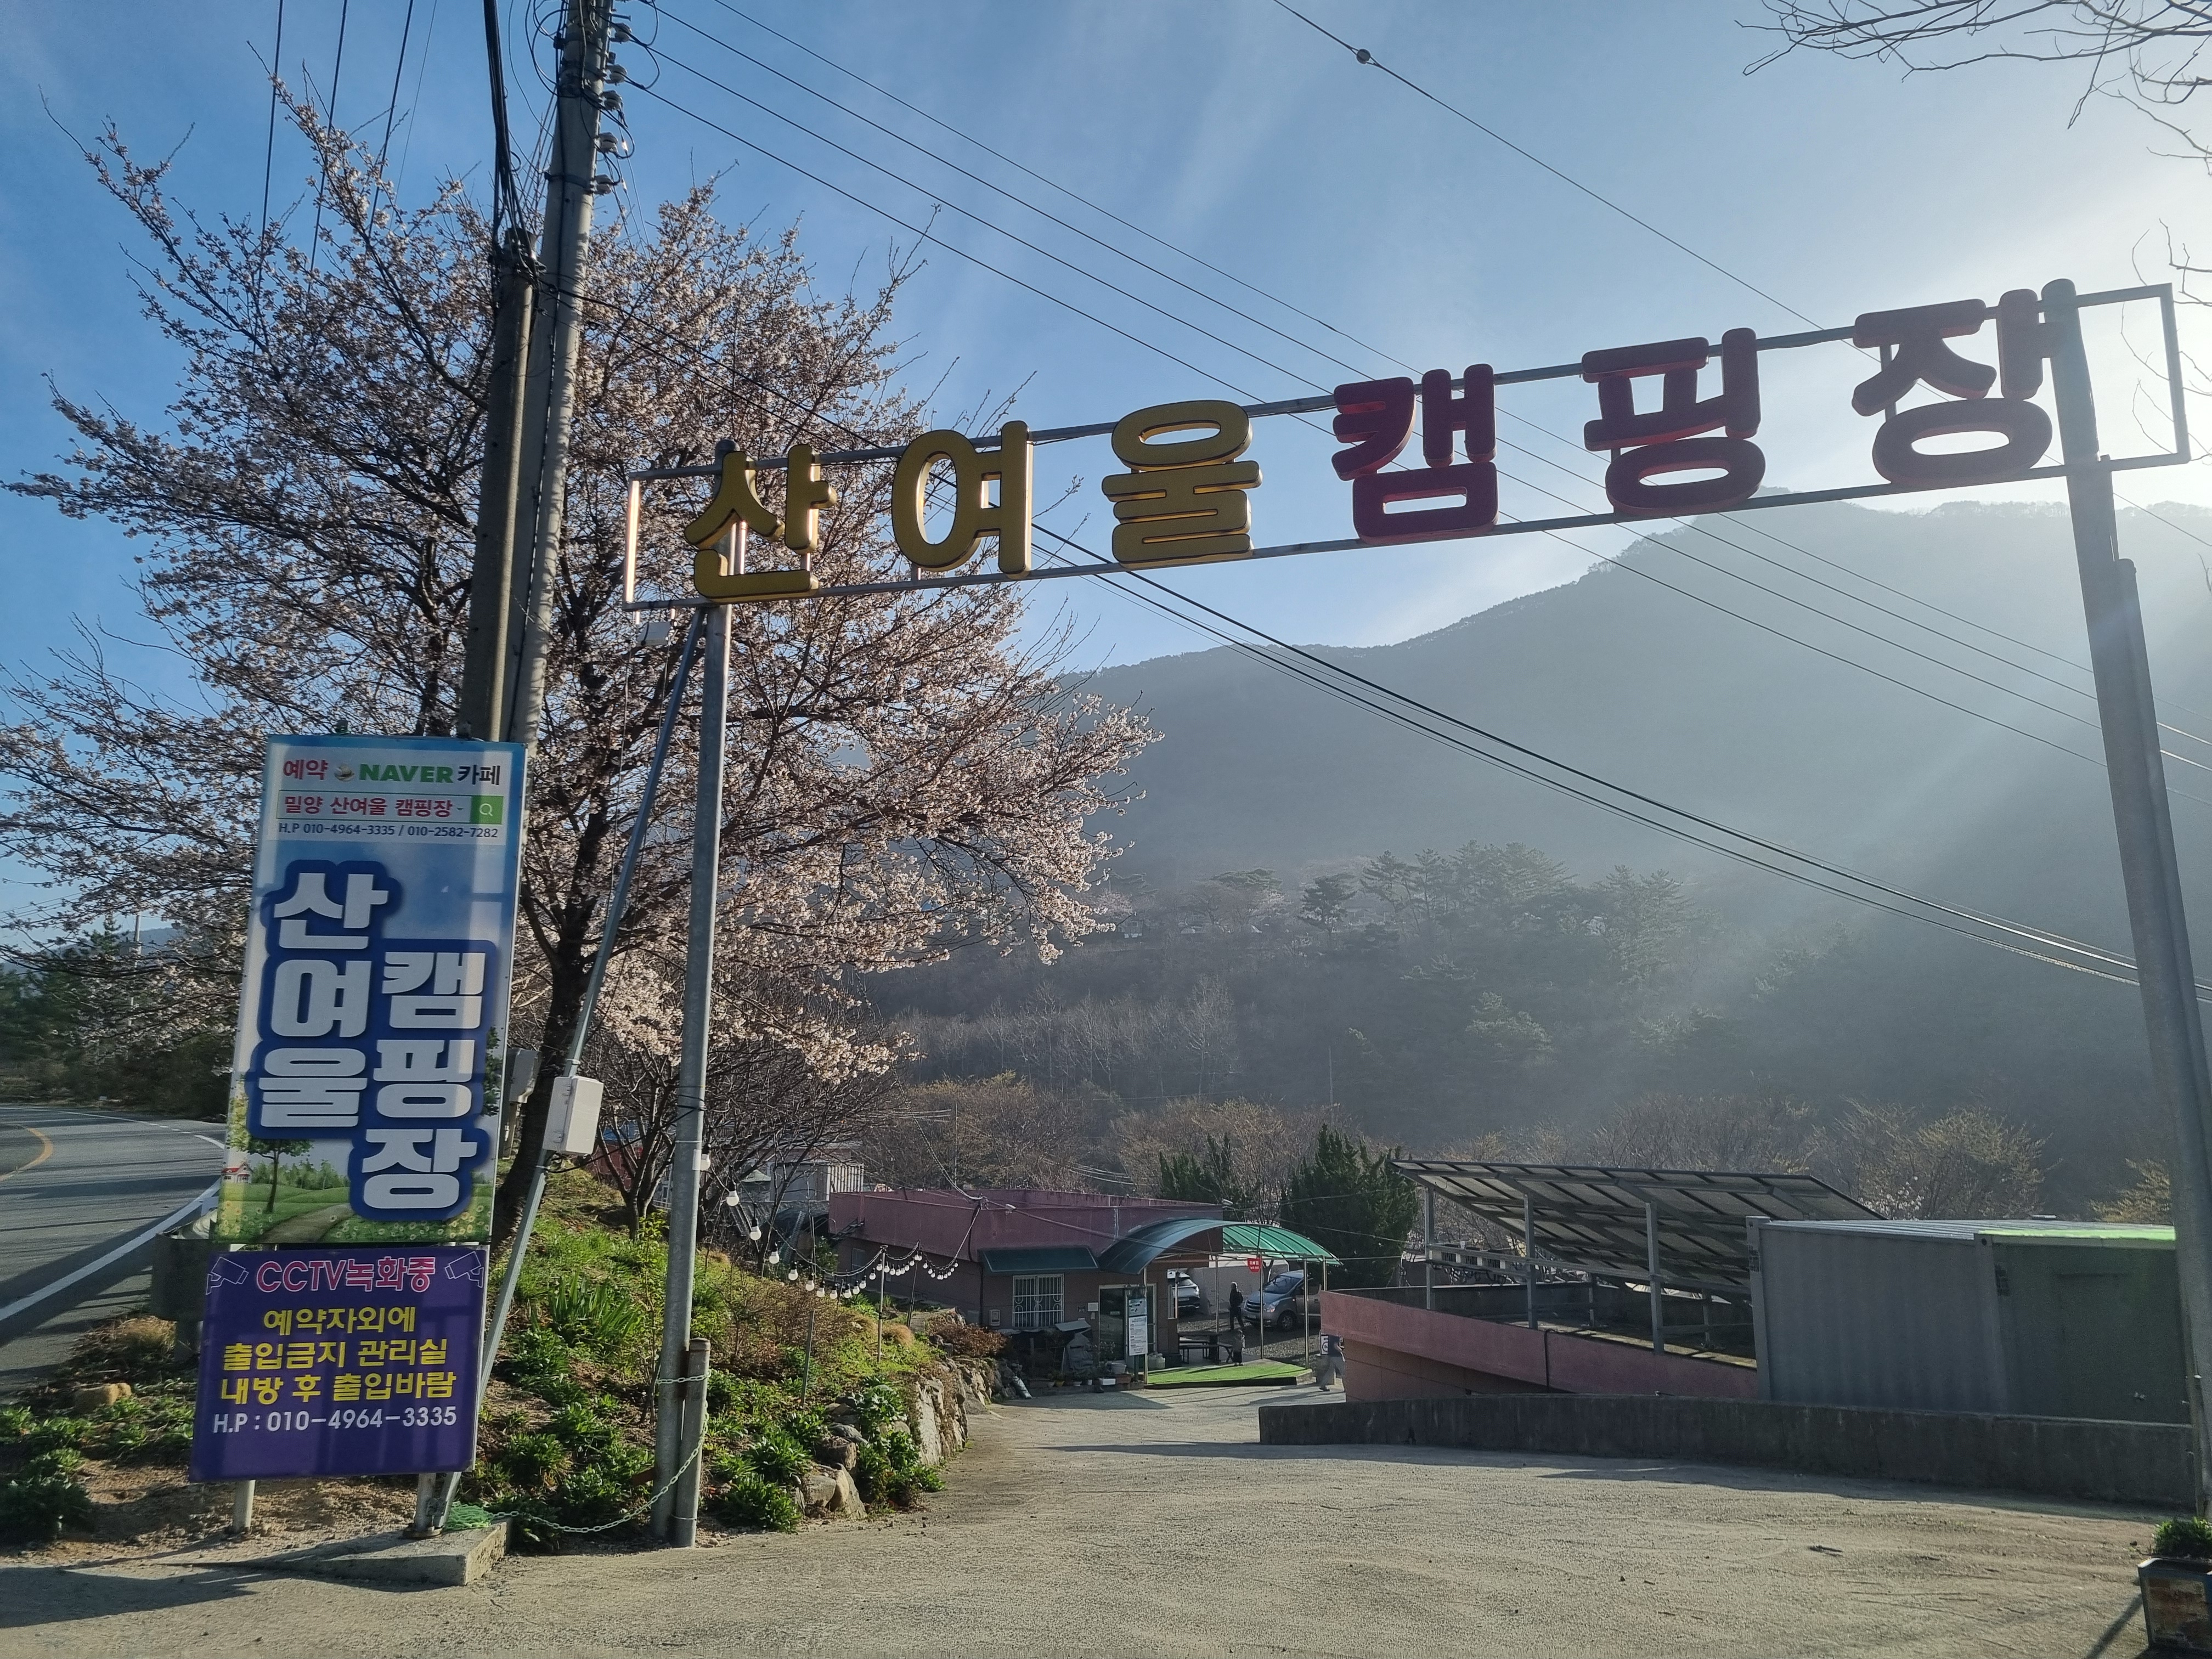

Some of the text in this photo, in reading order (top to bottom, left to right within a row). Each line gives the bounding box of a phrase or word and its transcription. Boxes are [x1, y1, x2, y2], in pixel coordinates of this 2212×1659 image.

[283, 759, 328, 780] 예약
[285, 795, 453, 817] 밀양 산여울 캠핑장
[278, 823, 300, 833] H.P
[303, 823, 395, 836] 010-4964-3335
[407, 826, 498, 838] 010-2582-7282
[258, 872, 389, 1128] 산여울
[362, 952, 486, 1210] 캠핑장
[263, 1306, 416, 1335] 예약자외에
[224, 1339, 448, 1371] 출입금지 관리실
[221, 1372, 456, 1405] 내방 후 출입바람
[267, 1406, 458, 1432] 010-4964-3335
